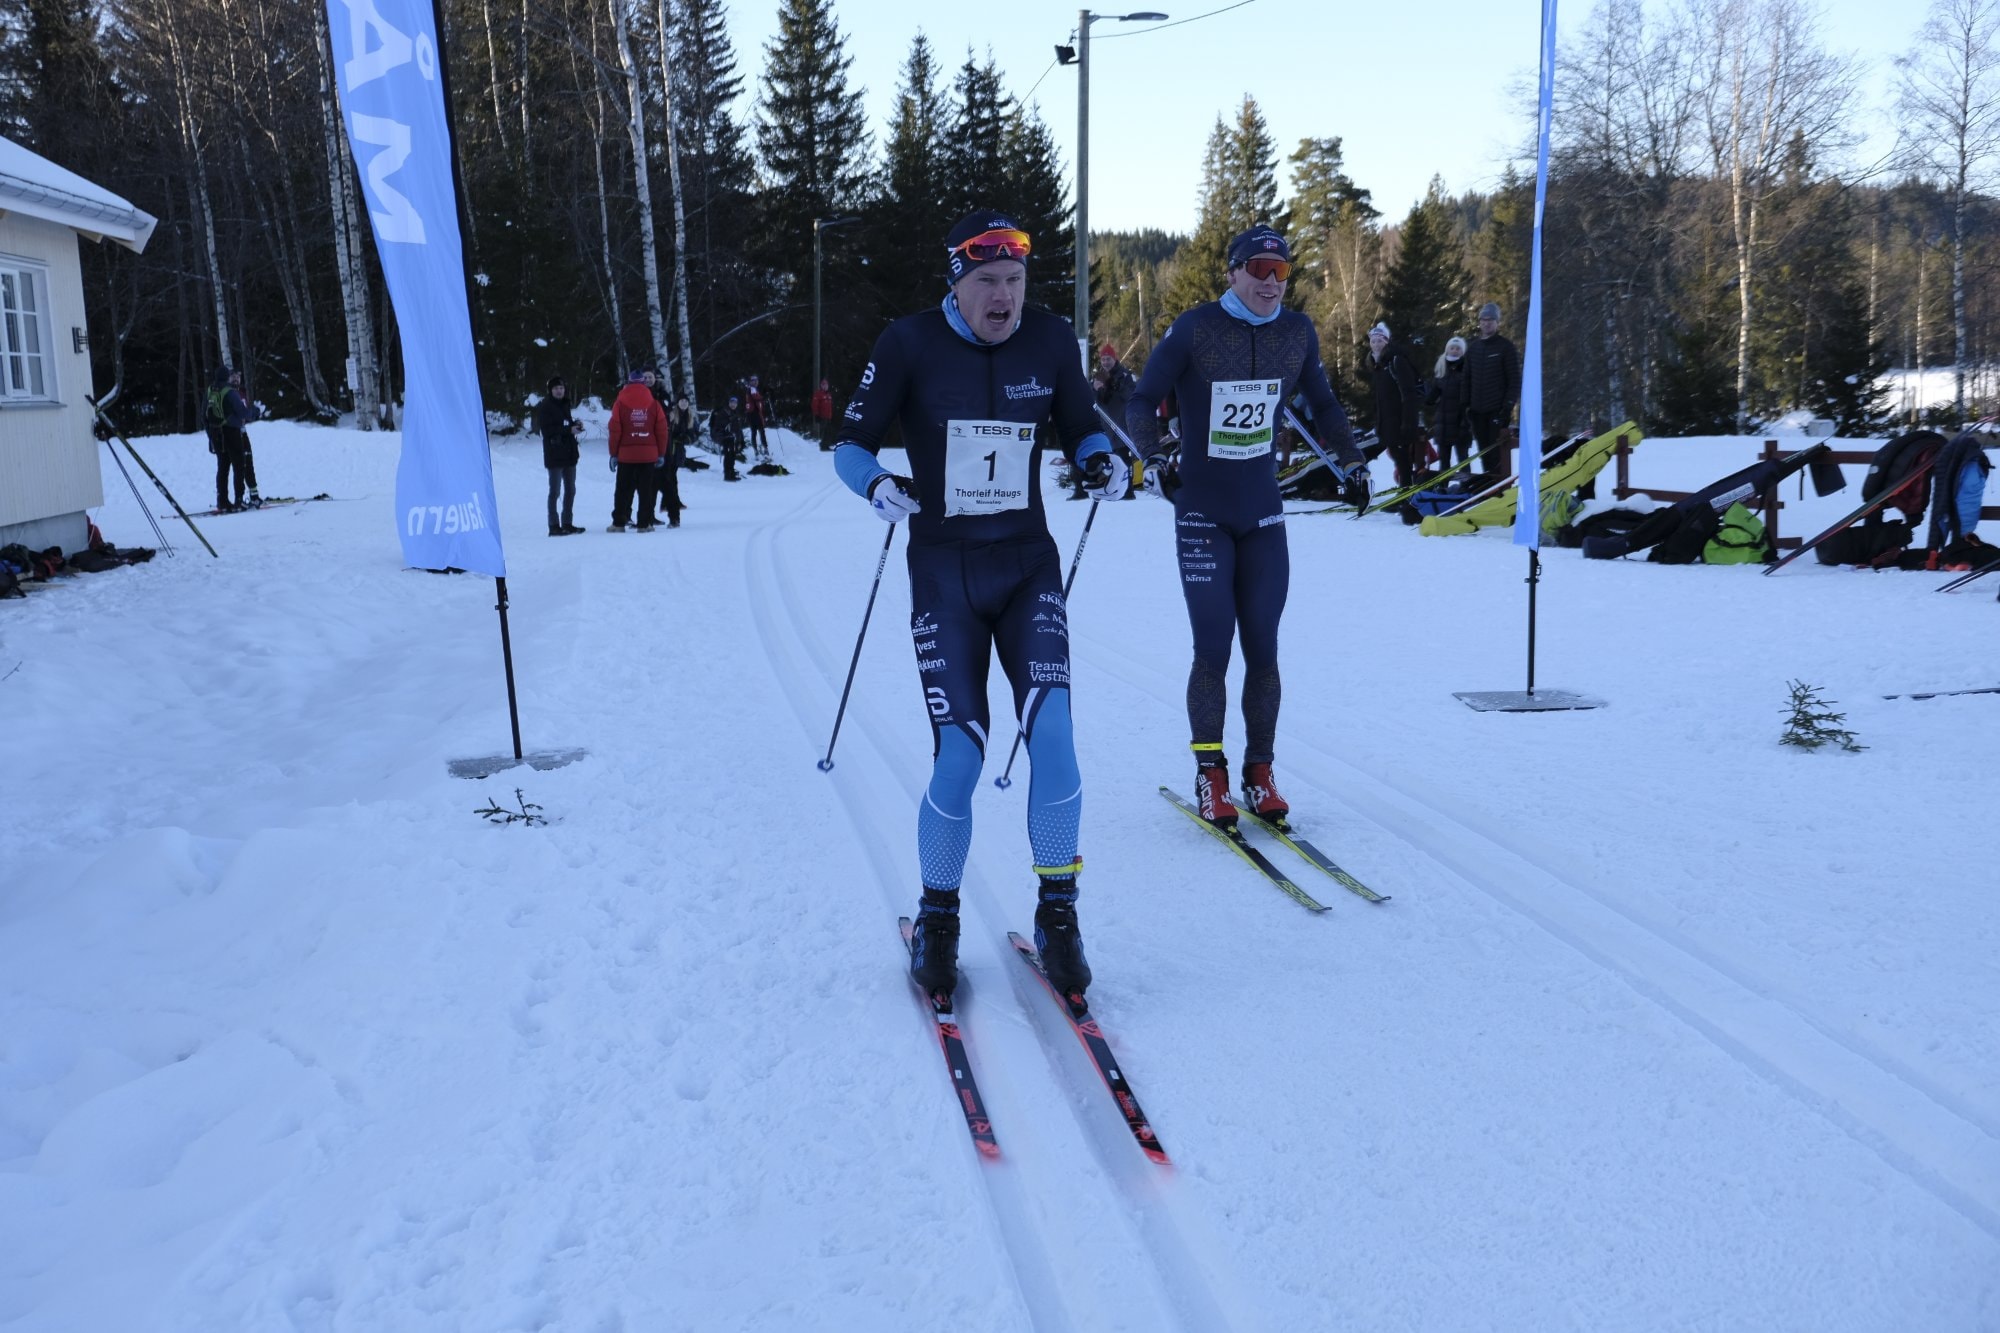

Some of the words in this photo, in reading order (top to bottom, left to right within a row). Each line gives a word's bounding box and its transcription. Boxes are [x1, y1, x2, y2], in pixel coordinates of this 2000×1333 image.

[1004, 384, 1031, 393] Team
[1006, 386, 1053, 400] Vestmarka
[1231, 384, 1262, 393] TESS
[1221, 402, 1266, 429] 223
[972, 425, 1012, 436] TESS
[1217, 432, 1248, 440] Thorleif
[983, 450, 997, 482] 1
[955, 488, 991, 498] Thorleif
[994, 488, 1022, 499] Haugs
[1028, 661, 1063, 671] Team
